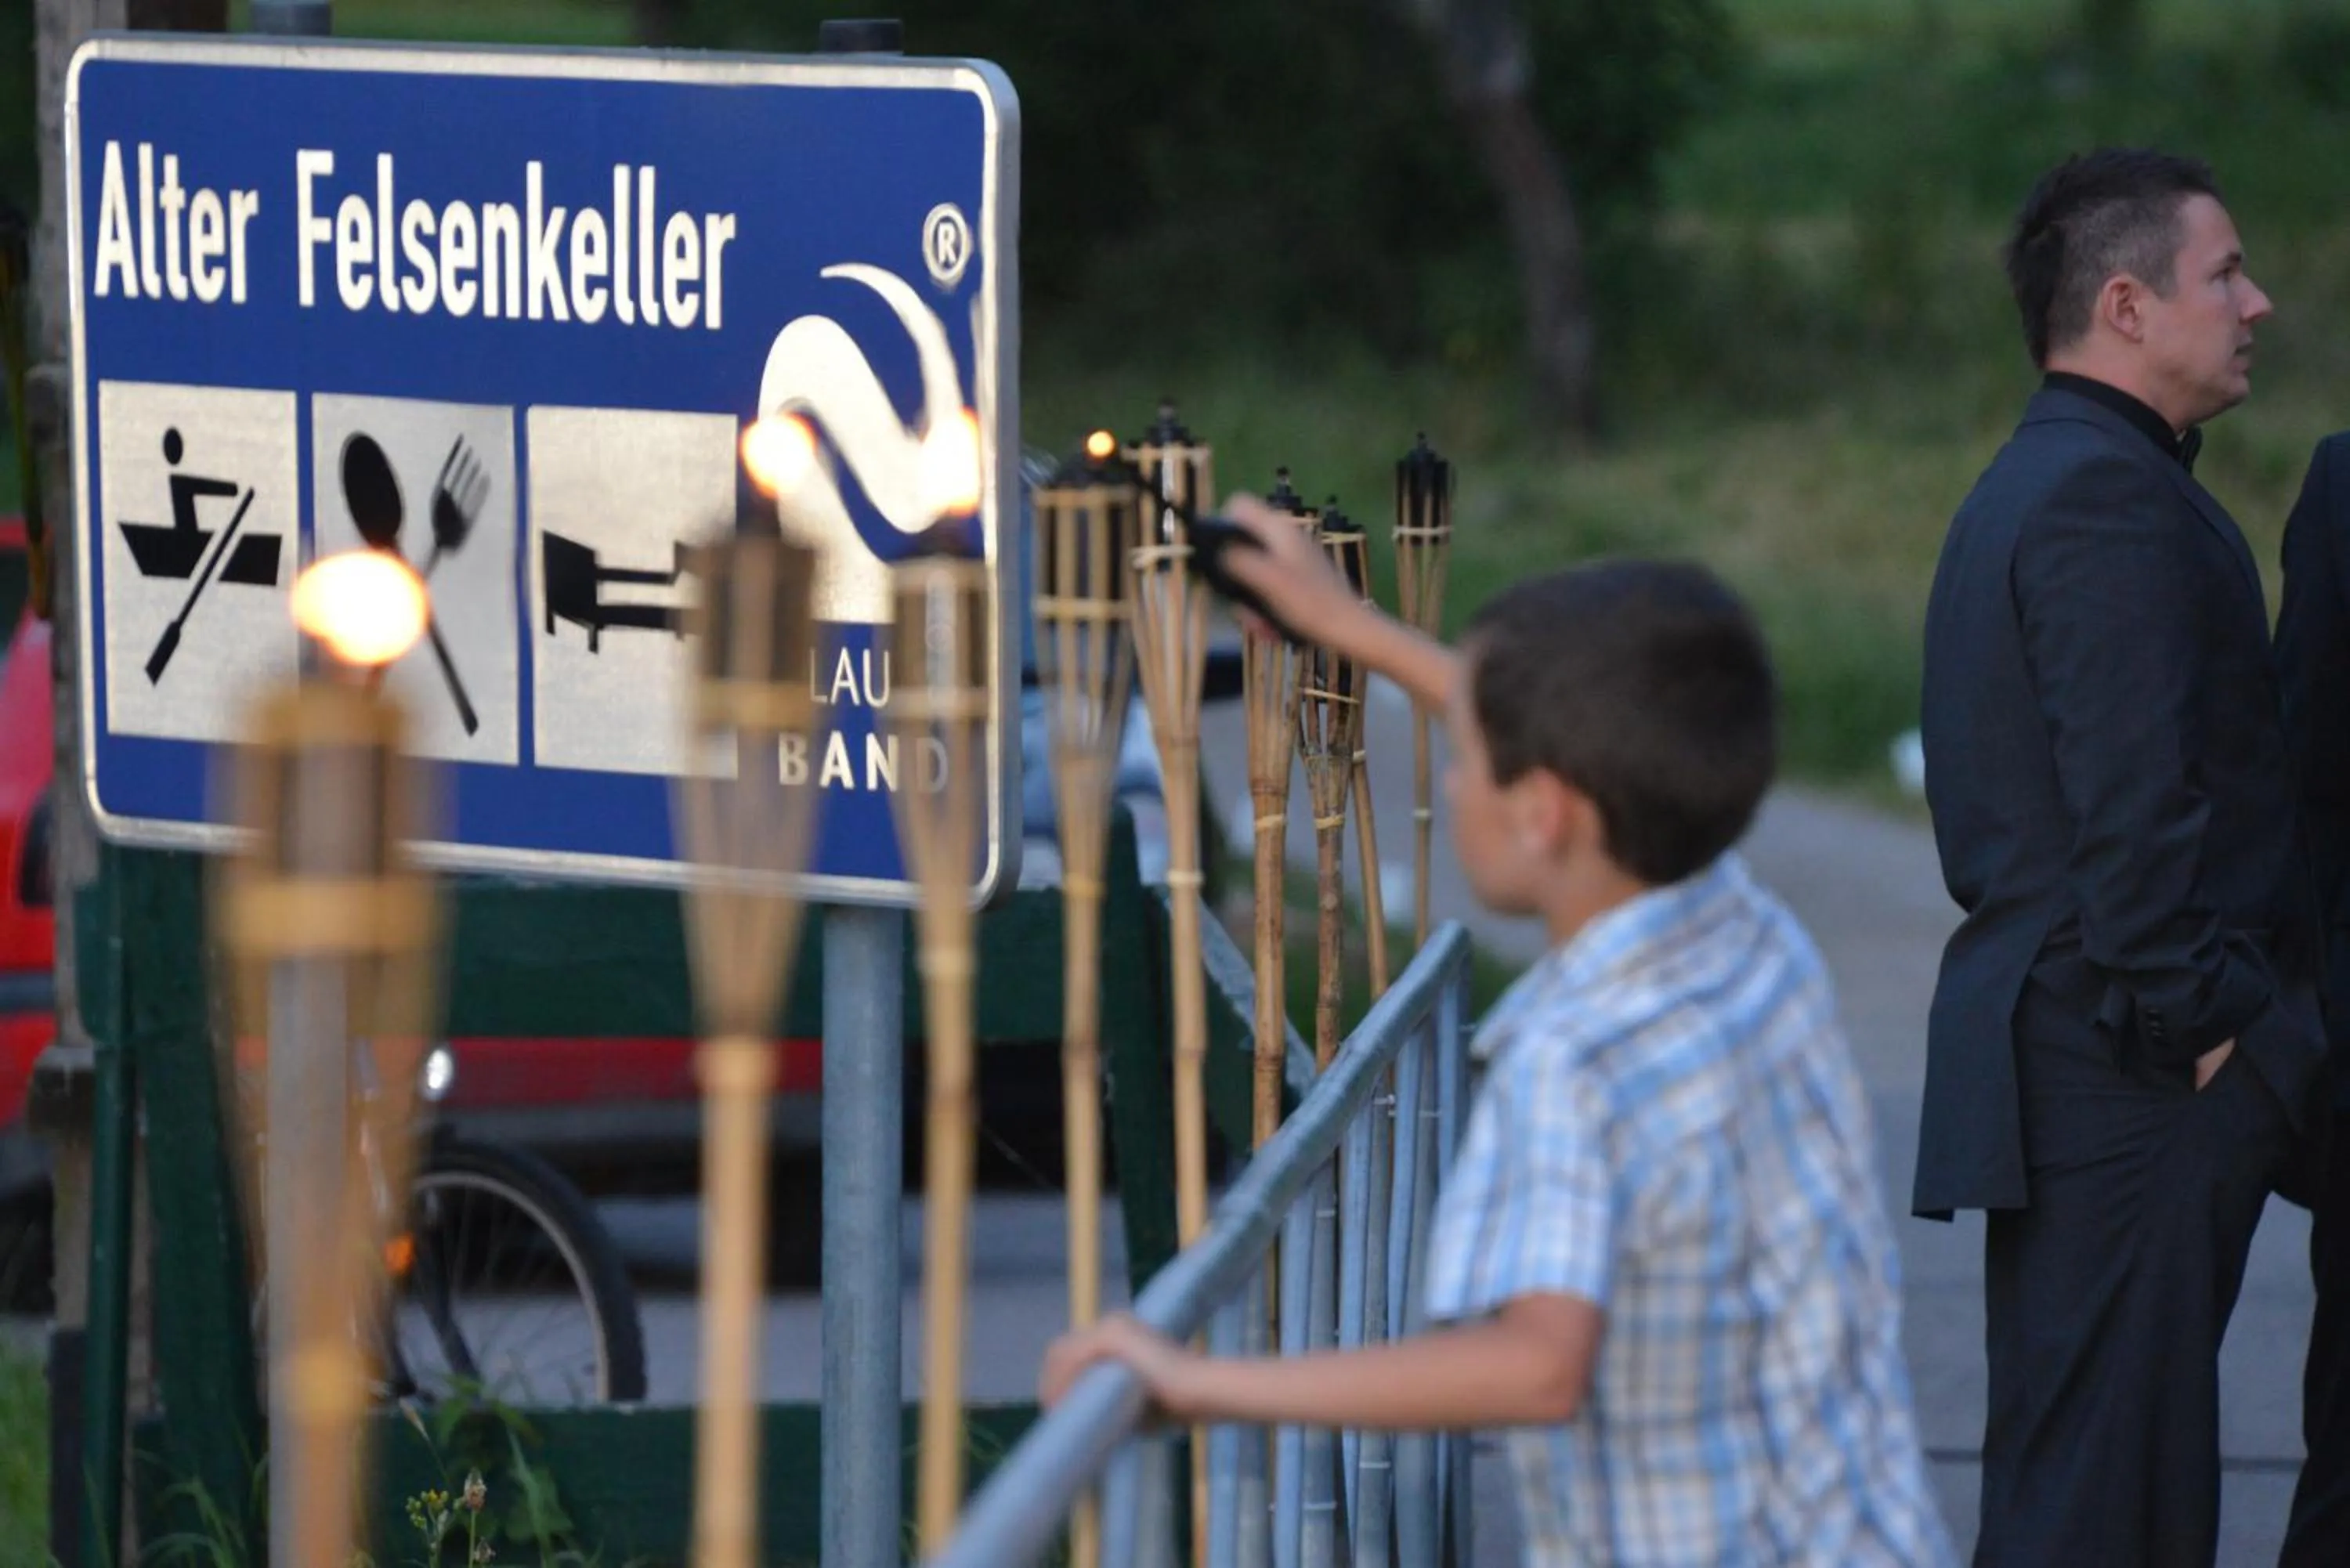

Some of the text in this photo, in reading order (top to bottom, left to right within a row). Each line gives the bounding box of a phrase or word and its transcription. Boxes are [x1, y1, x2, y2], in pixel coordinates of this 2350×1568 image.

[93, 139, 736, 331] Alter Felsenkeller
[809, 646, 890, 708] LAU
[777, 729, 949, 793] BAND
